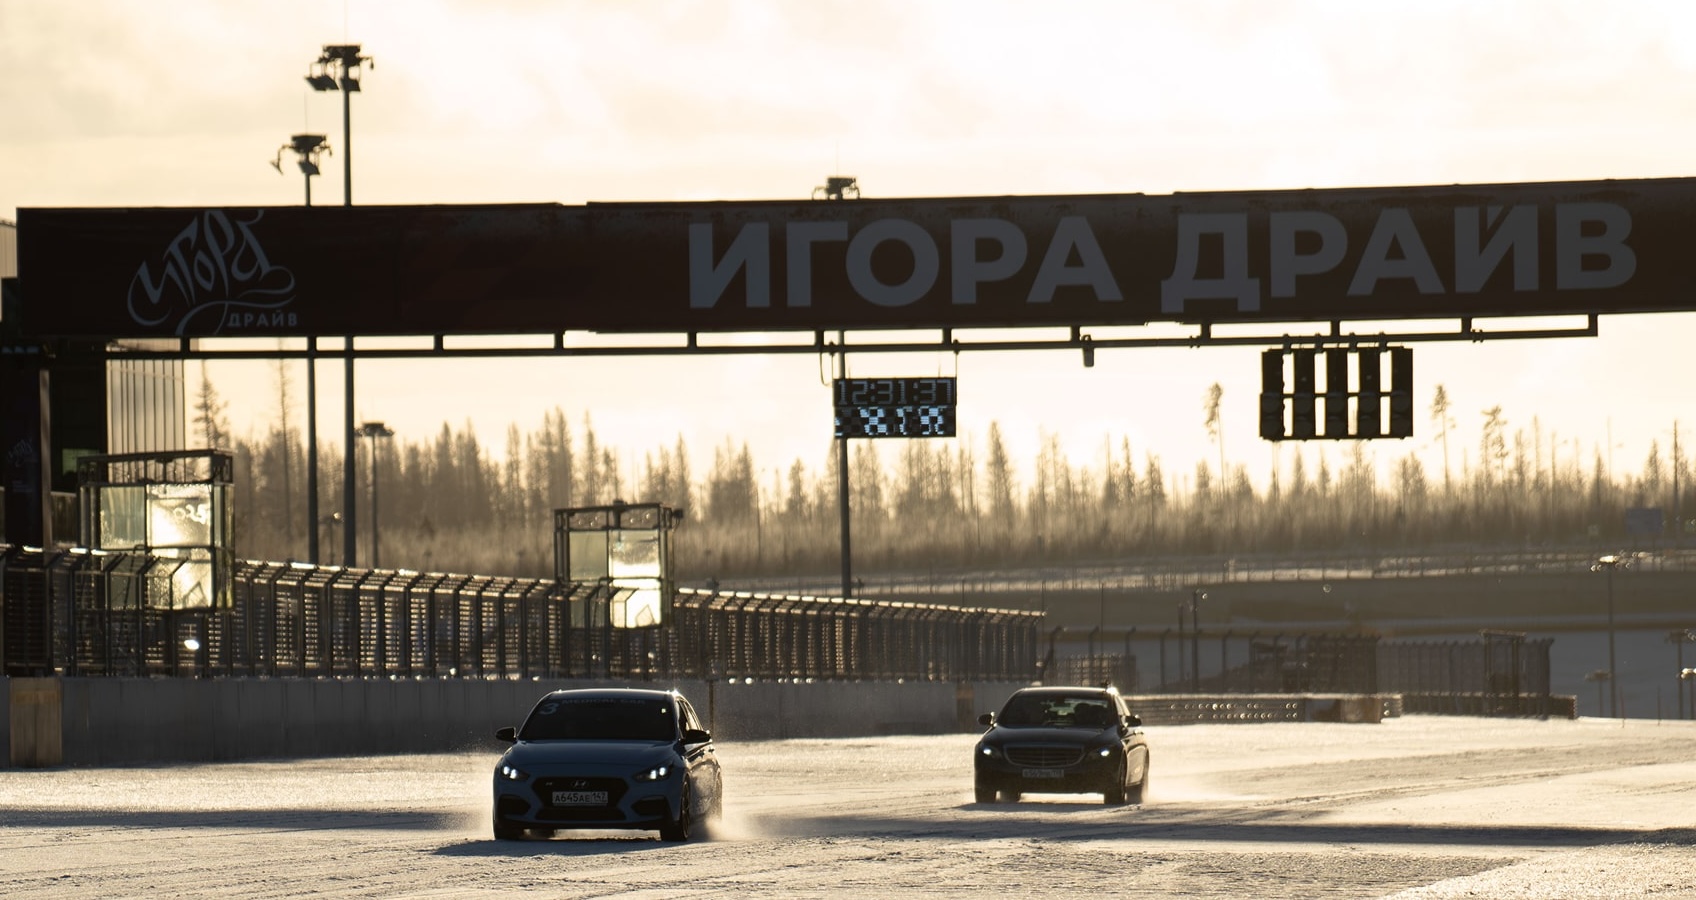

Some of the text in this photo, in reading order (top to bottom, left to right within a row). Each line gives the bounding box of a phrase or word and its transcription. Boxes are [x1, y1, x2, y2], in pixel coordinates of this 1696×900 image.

[688, 202, 1637, 314] ИГОРА ДРАЙВ
[226, 309, 298, 328] ДРАЙВ
[838, 379, 952, 405] 12:31:37
[538, 702, 560, 716] 3
